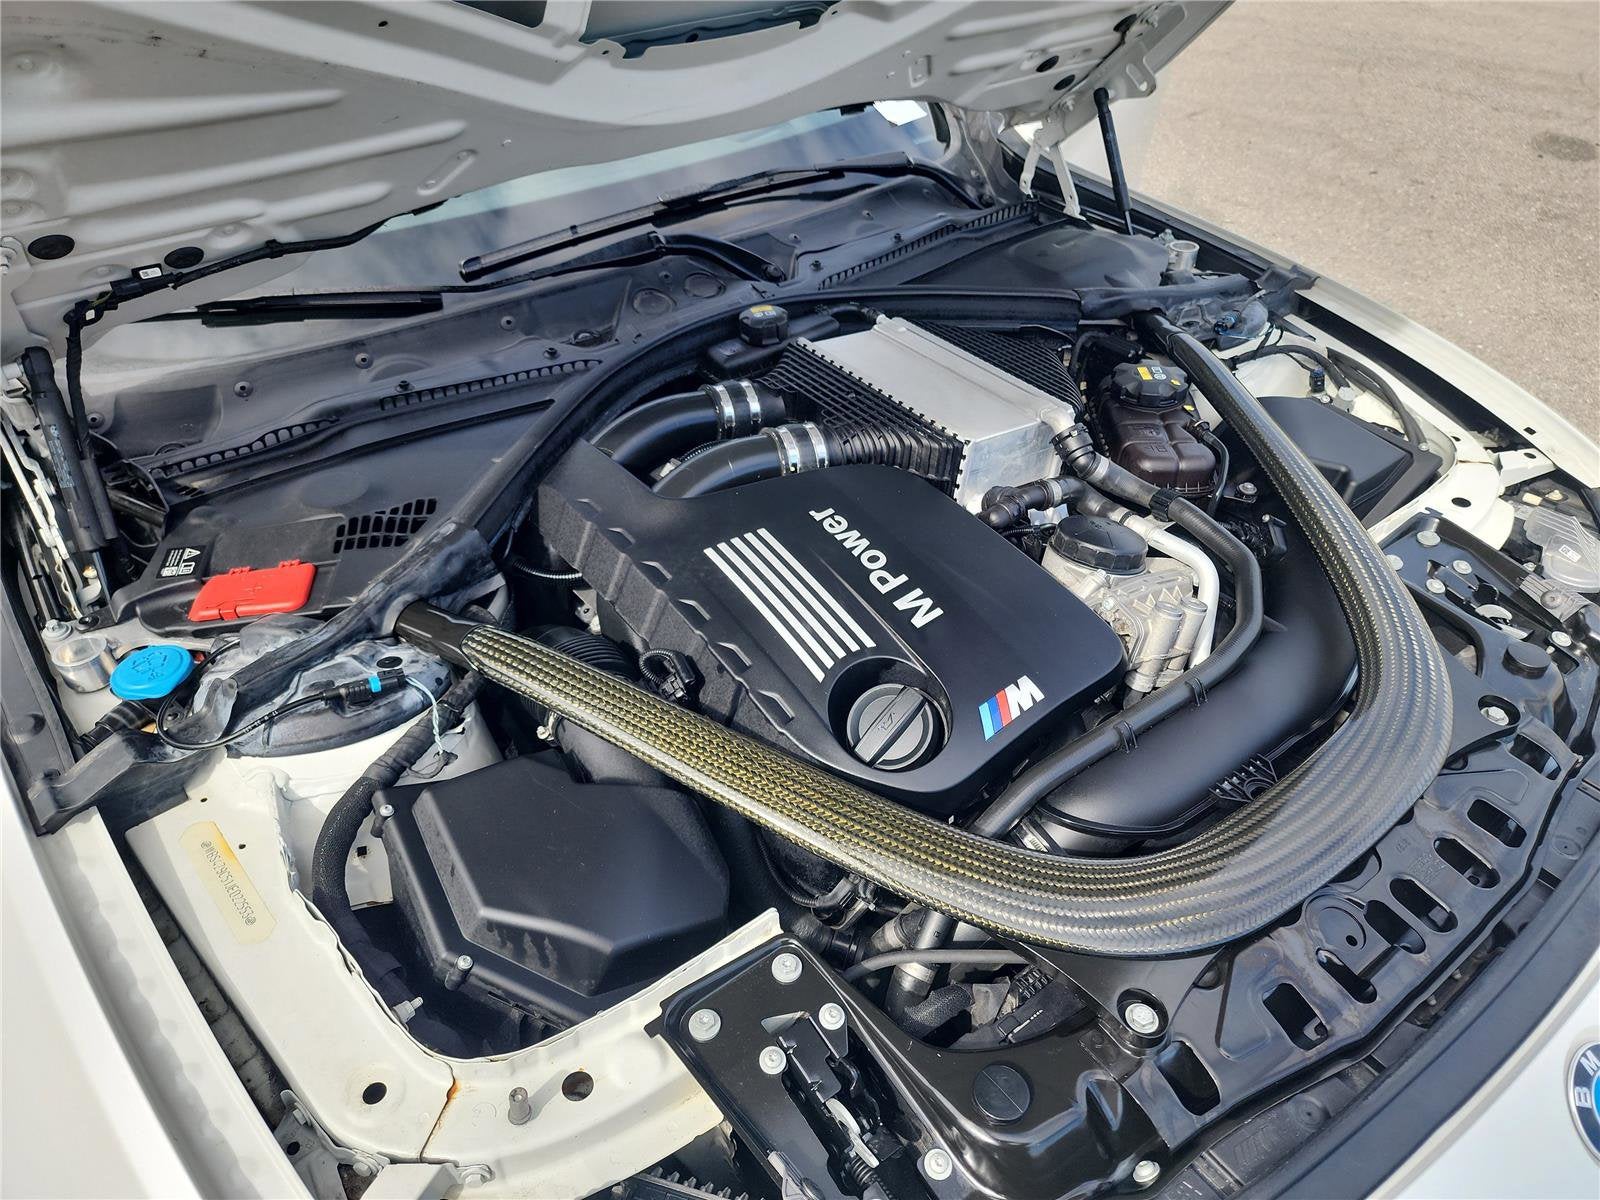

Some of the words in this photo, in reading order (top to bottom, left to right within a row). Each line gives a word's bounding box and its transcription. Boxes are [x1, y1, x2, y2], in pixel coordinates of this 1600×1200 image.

[808, 507, 909, 595] Power
[892, 588, 944, 629] M
[1575, 1050, 1600, 1108] BM
